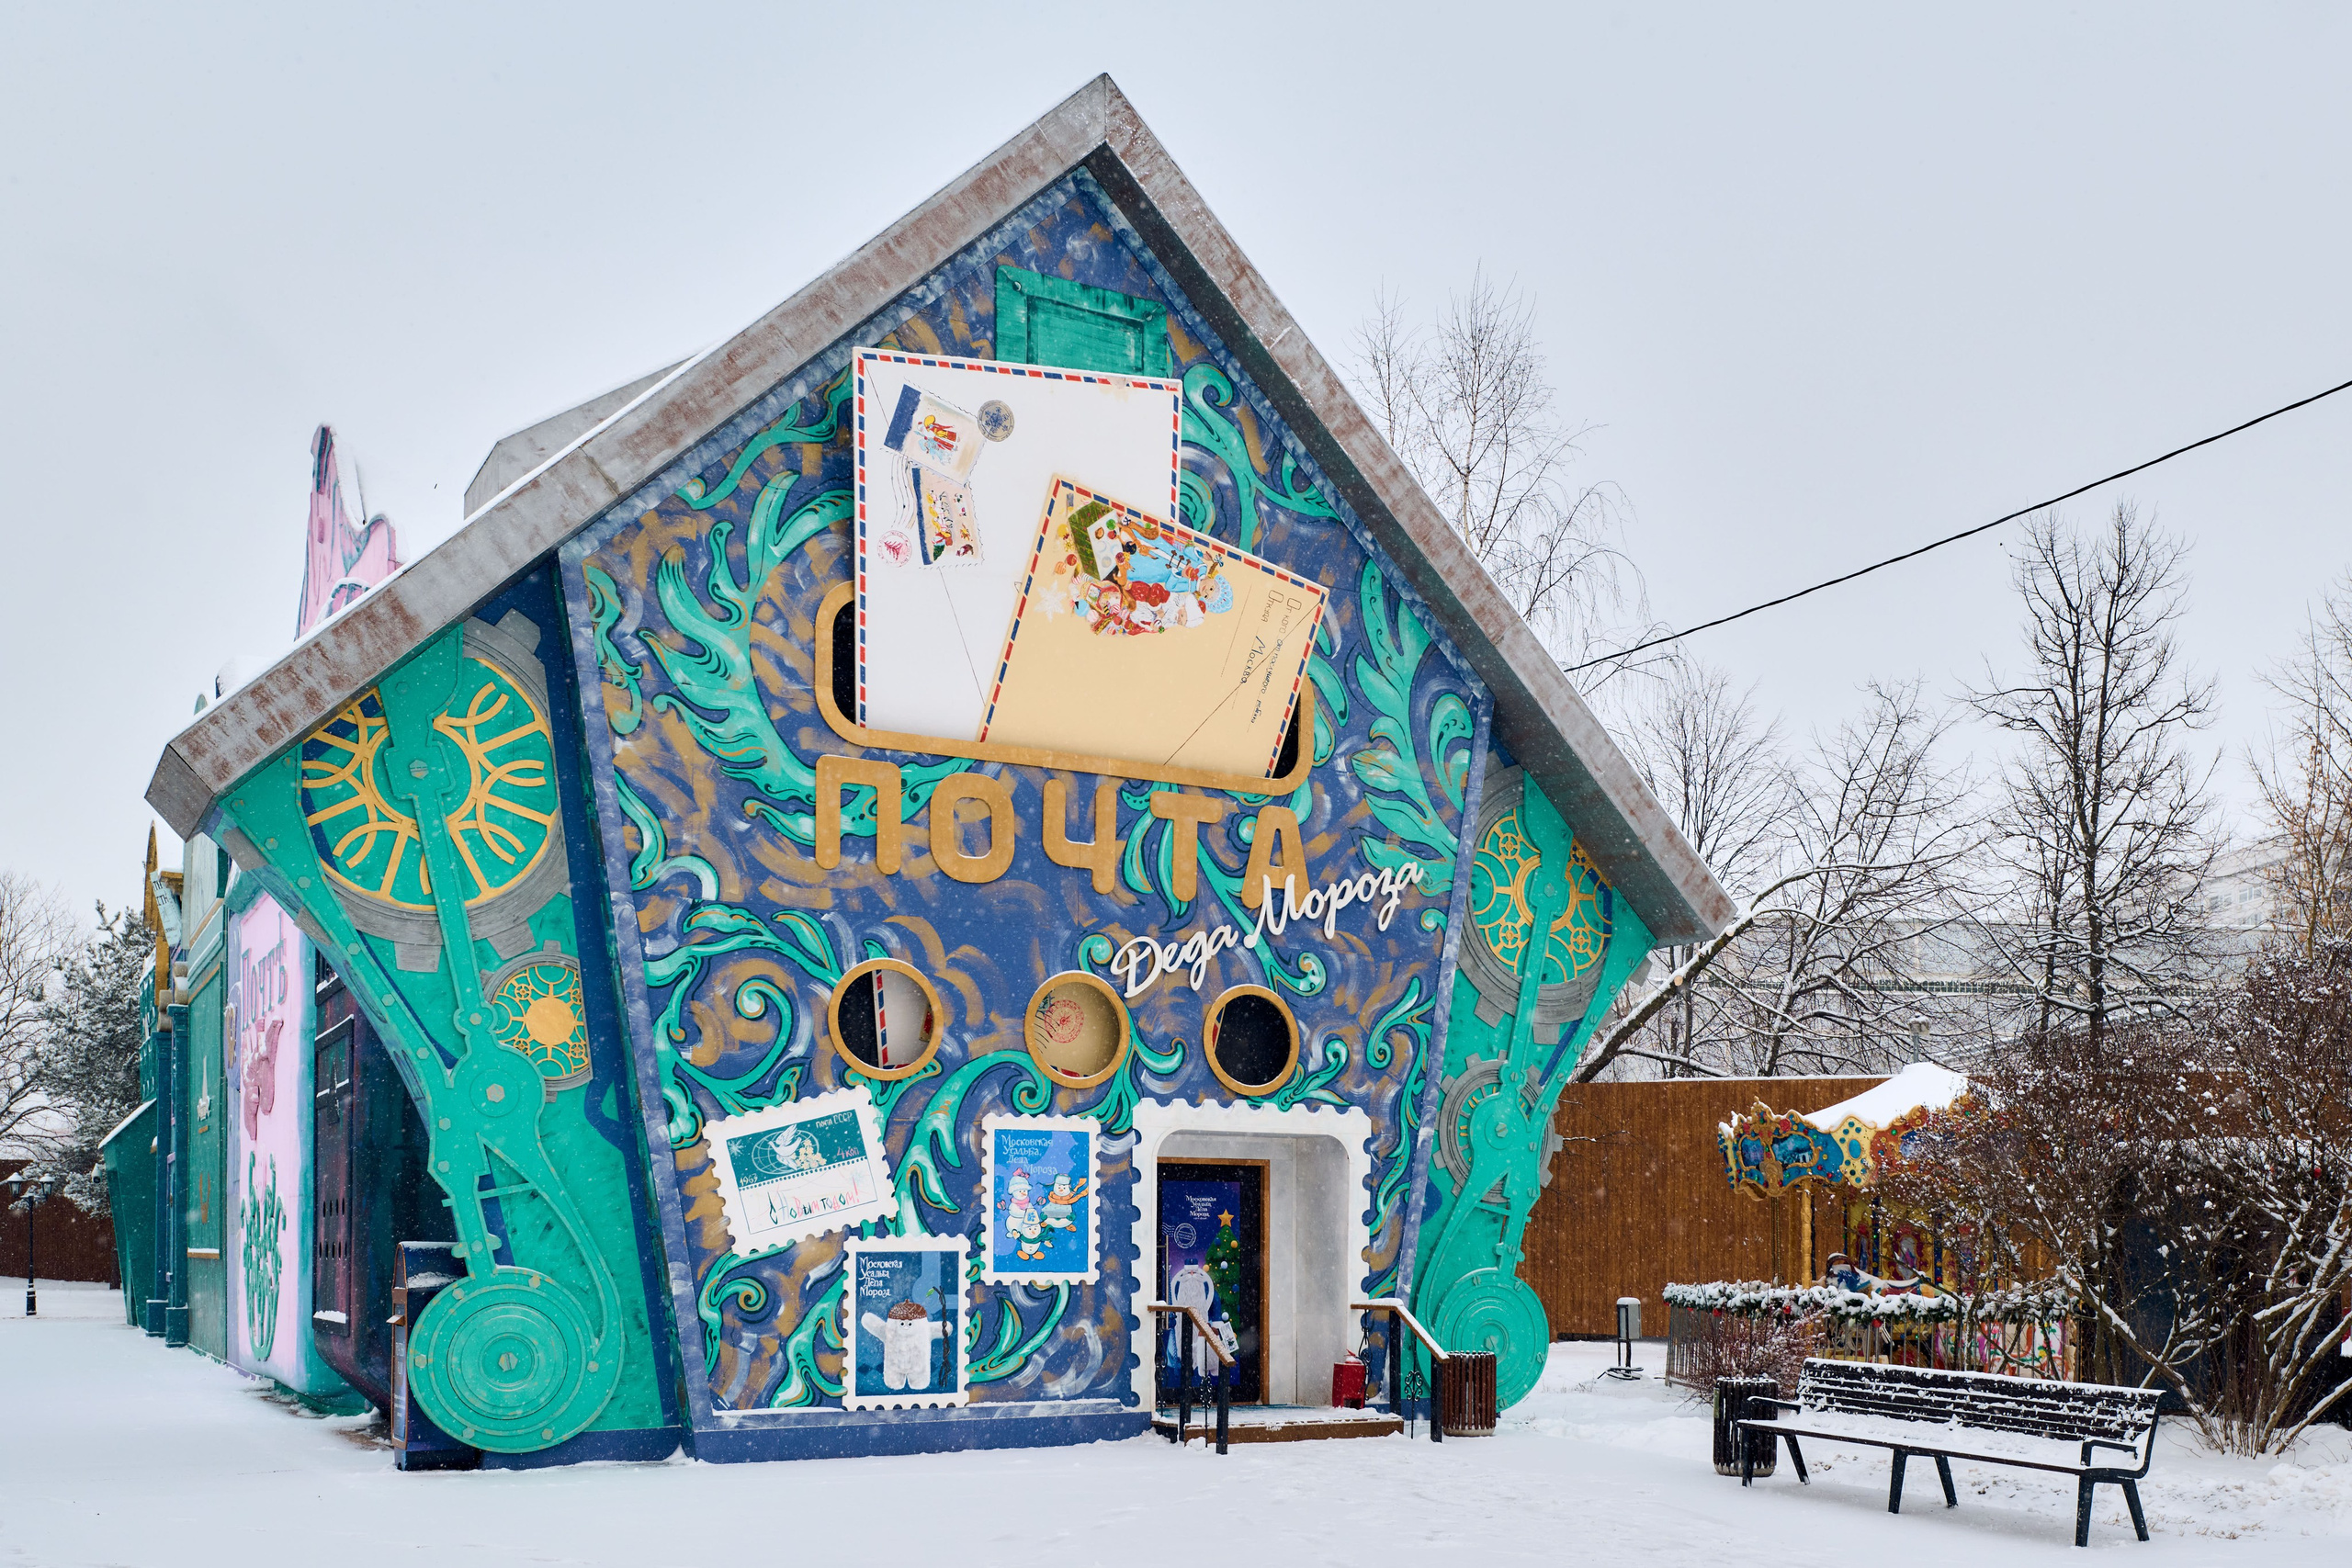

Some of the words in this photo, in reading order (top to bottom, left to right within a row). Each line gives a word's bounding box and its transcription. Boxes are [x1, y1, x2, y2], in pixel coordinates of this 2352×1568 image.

[1240, 636, 1266, 684] Москва
[815, 753, 1311, 908] ПОЧТА
[1110, 924, 1238, 998] Деда
[1243, 861, 1424, 949] Мороза
[832, 1111, 853, 1125] СССР
[1001, 1134, 1054, 1147] Московская
[837, 1145, 845, 1159] 4
[1023, 1163, 1058, 1176] Мороза
[740, 1172, 759, 1188] 1963
[859, 1256, 903, 1269] Московская
[859, 1286, 891, 1299] Мороза
